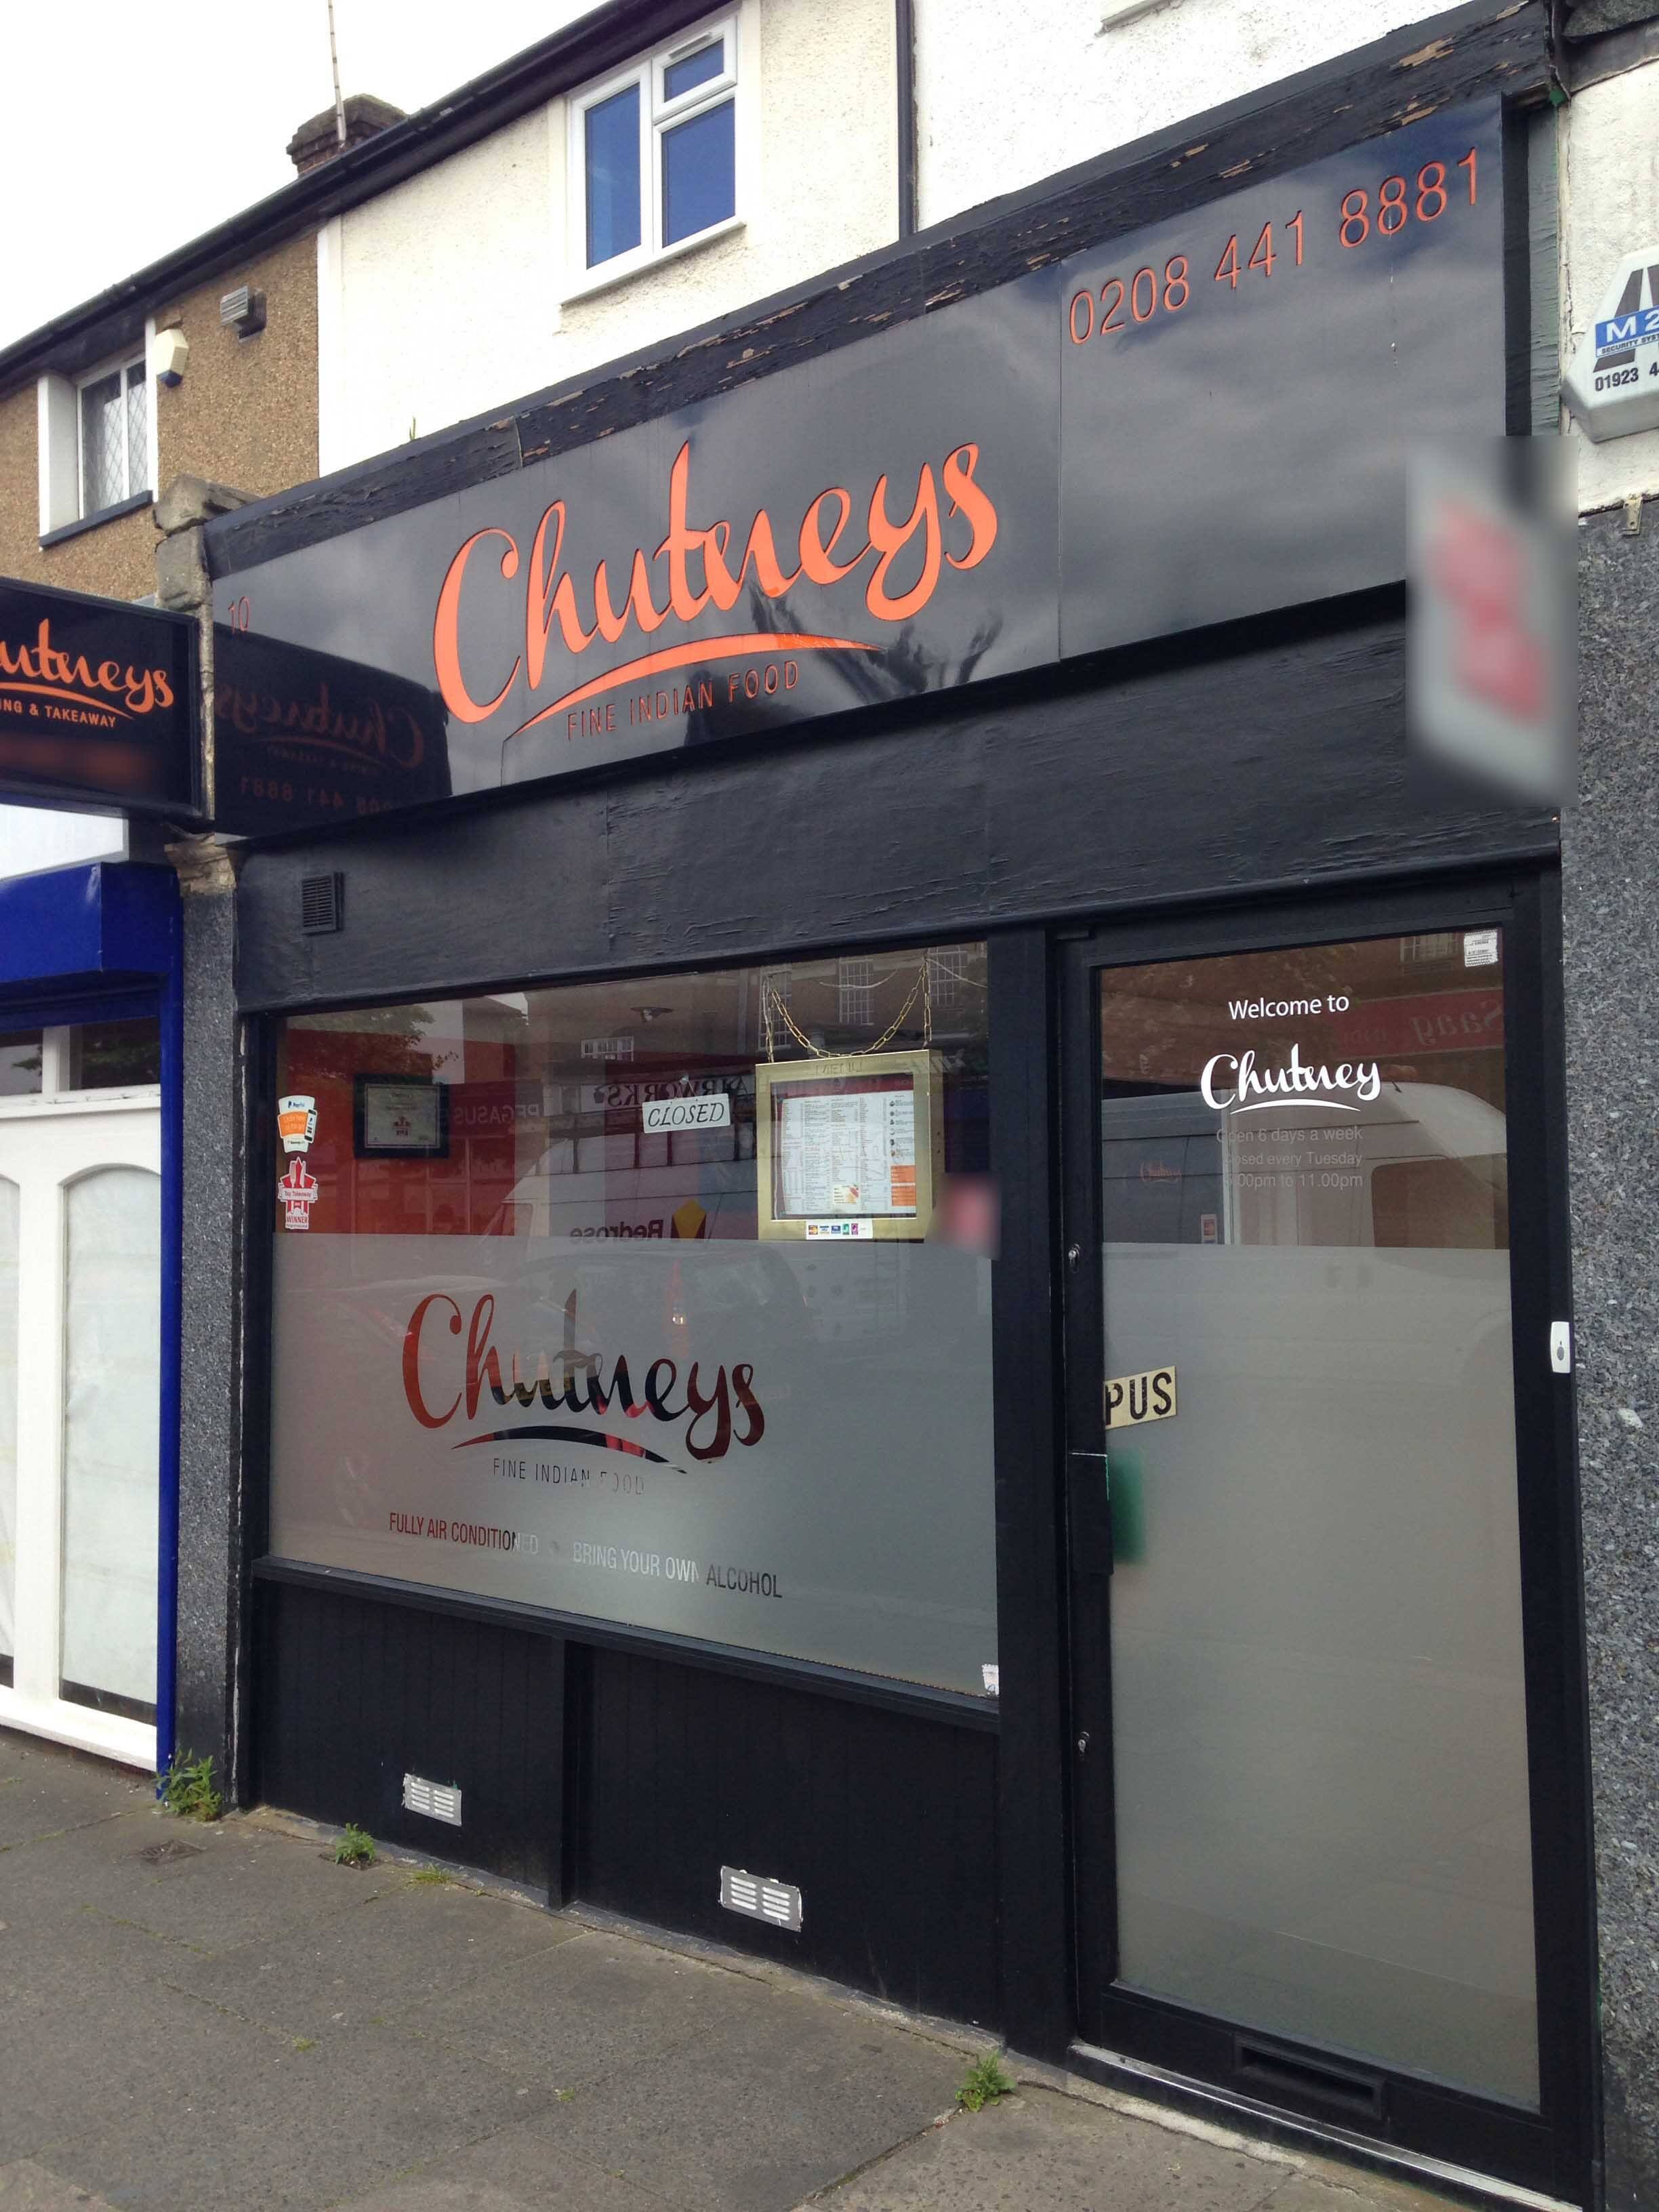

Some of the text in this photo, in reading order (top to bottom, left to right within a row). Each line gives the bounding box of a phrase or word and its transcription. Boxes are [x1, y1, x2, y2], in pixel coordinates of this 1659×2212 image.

[1069, 147, 1478, 344] 0208 441 8881
[1606, 316, 1637, 342] M
[1601, 339, 1639, 354] SECURITY
[1595, 367, 1639, 392] 01923
[432, 441, 998, 723] Chutneys
[227, 596, 251, 634] 10
[567, 660, 799, 740] FINE INDIAN FOOD
[29, 702, 39, 717] &
[45, 705, 117, 728] TAKEAWAY
[1228, 994, 1349, 1020] Welcome to
[1200, 1043, 1380, 1109] Chutney
[647, 1102, 725, 1128] CLOSED
[1258, 1128, 1268, 1143] 6
[1271, 1127, 1305, 1145] days
[1310, 1129, 1319, 1141] a
[1323, 1125, 1364, 1141] week
[1268, 1155, 1303, 1168] every
[1306, 1151, 1363, 1167] Tuesday
[1300, 1172, 1364, 1191] 11.00pm
[286, 1216, 308, 1224] WINNER
[403, 1288, 765, 1464] Chutneys
[493, 1457, 527, 1481] FINE
[535, 1462, 590, 1488] INDIAN
[389, 1511, 424, 1536] FULLY
[427, 1517, 448, 1540] AIR
[573, 1540, 783, 1599] BRING YOUR OWN ALCOHOL
